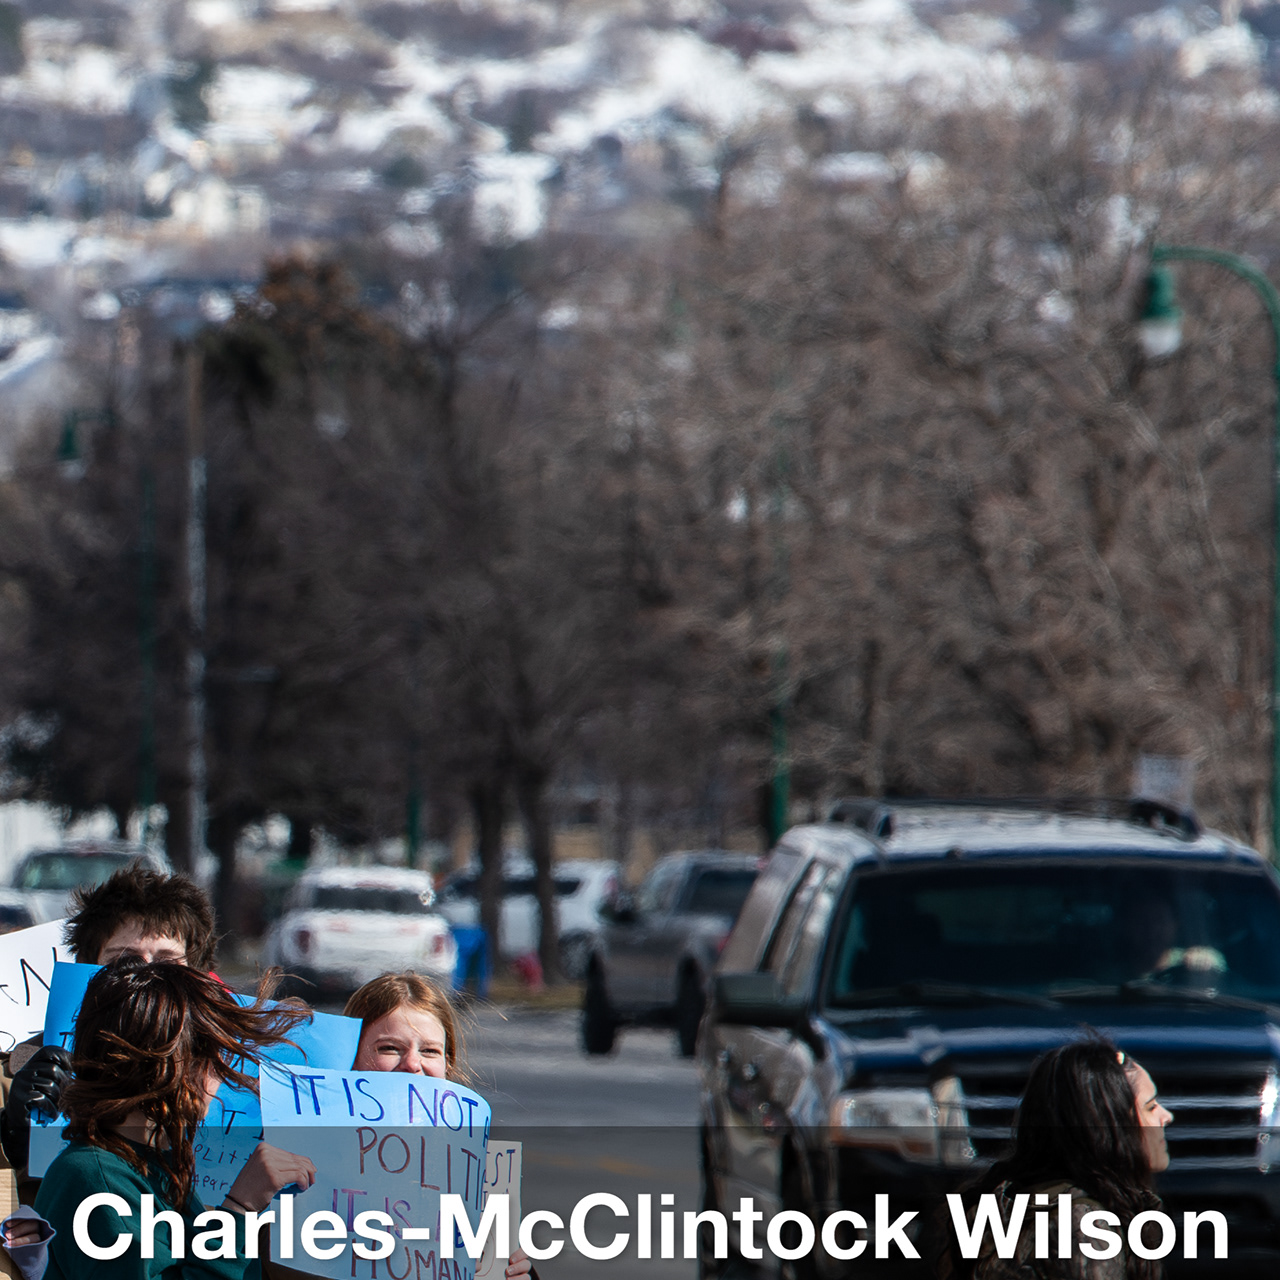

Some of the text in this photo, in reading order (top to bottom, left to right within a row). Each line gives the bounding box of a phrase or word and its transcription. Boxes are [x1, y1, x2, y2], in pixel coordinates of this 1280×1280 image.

[289, 1074, 326, 1117] IT
[341, 1077, 386, 1122] IS
[407, 1083, 480, 1139] NOT
